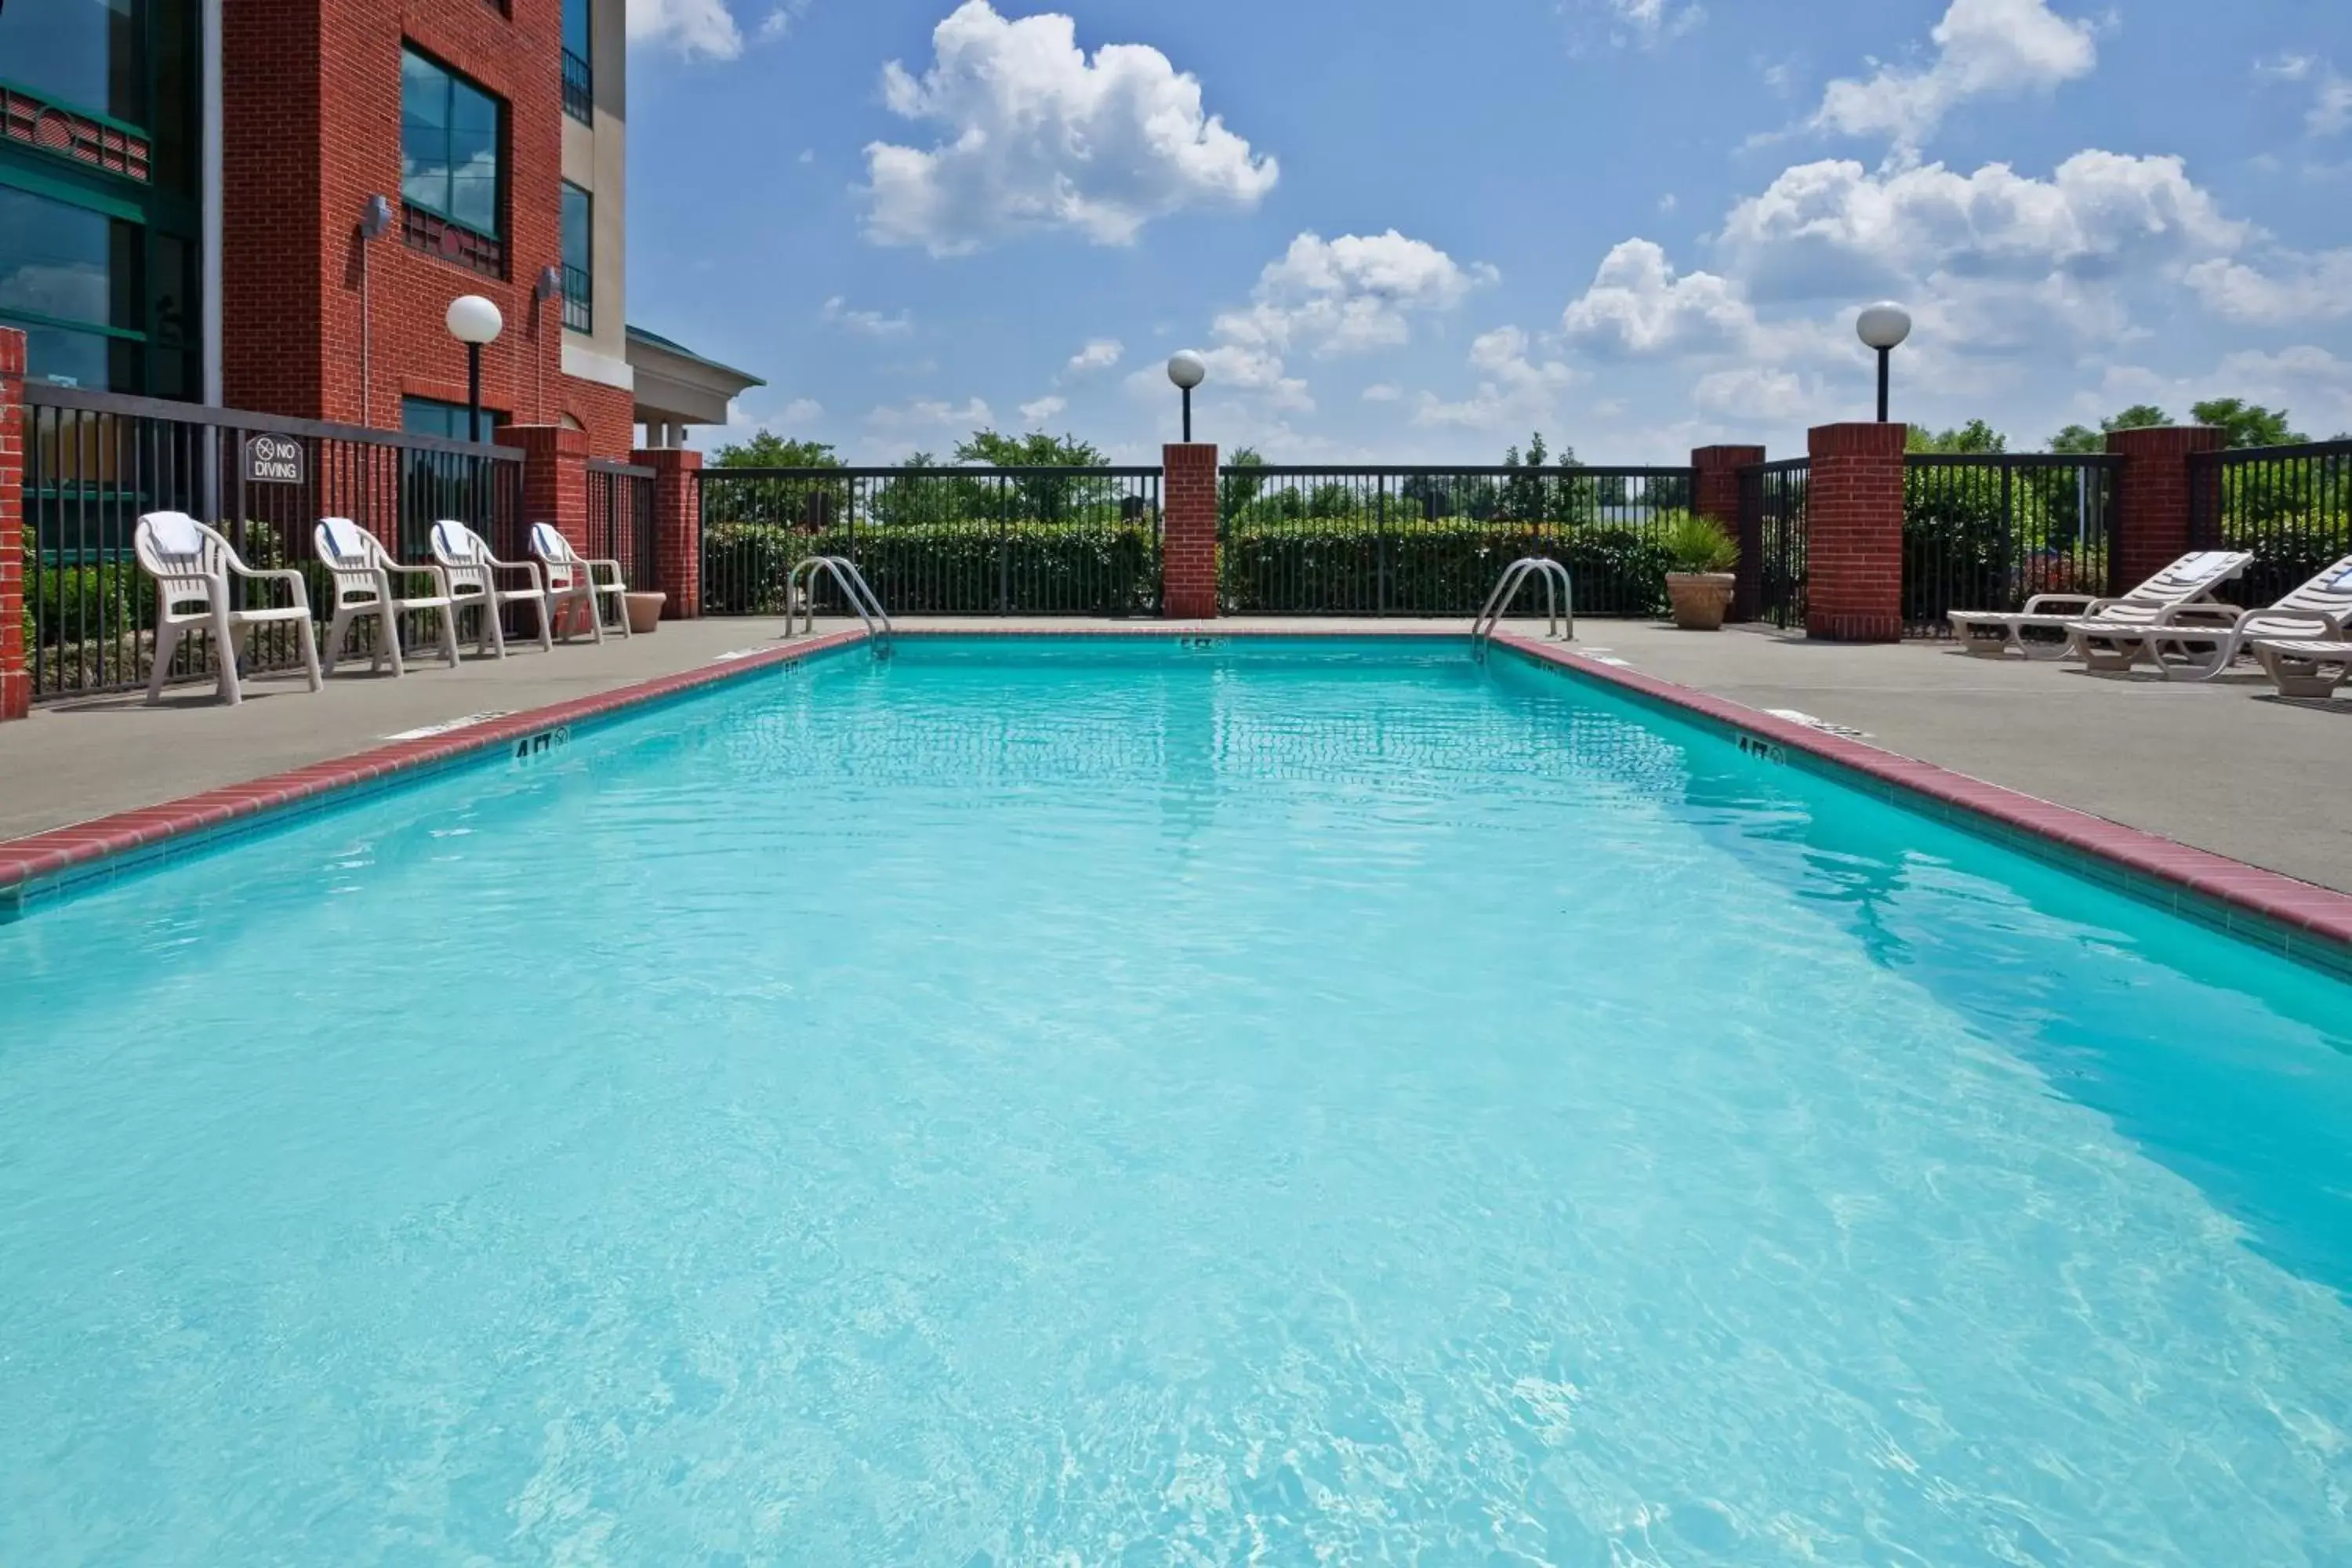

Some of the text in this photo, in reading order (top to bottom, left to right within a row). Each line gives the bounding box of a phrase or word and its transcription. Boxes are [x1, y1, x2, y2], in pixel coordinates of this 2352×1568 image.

[276, 443, 296, 459] NO
[255, 461, 296, 477] DIVING
[534, 732, 551, 753] FT
